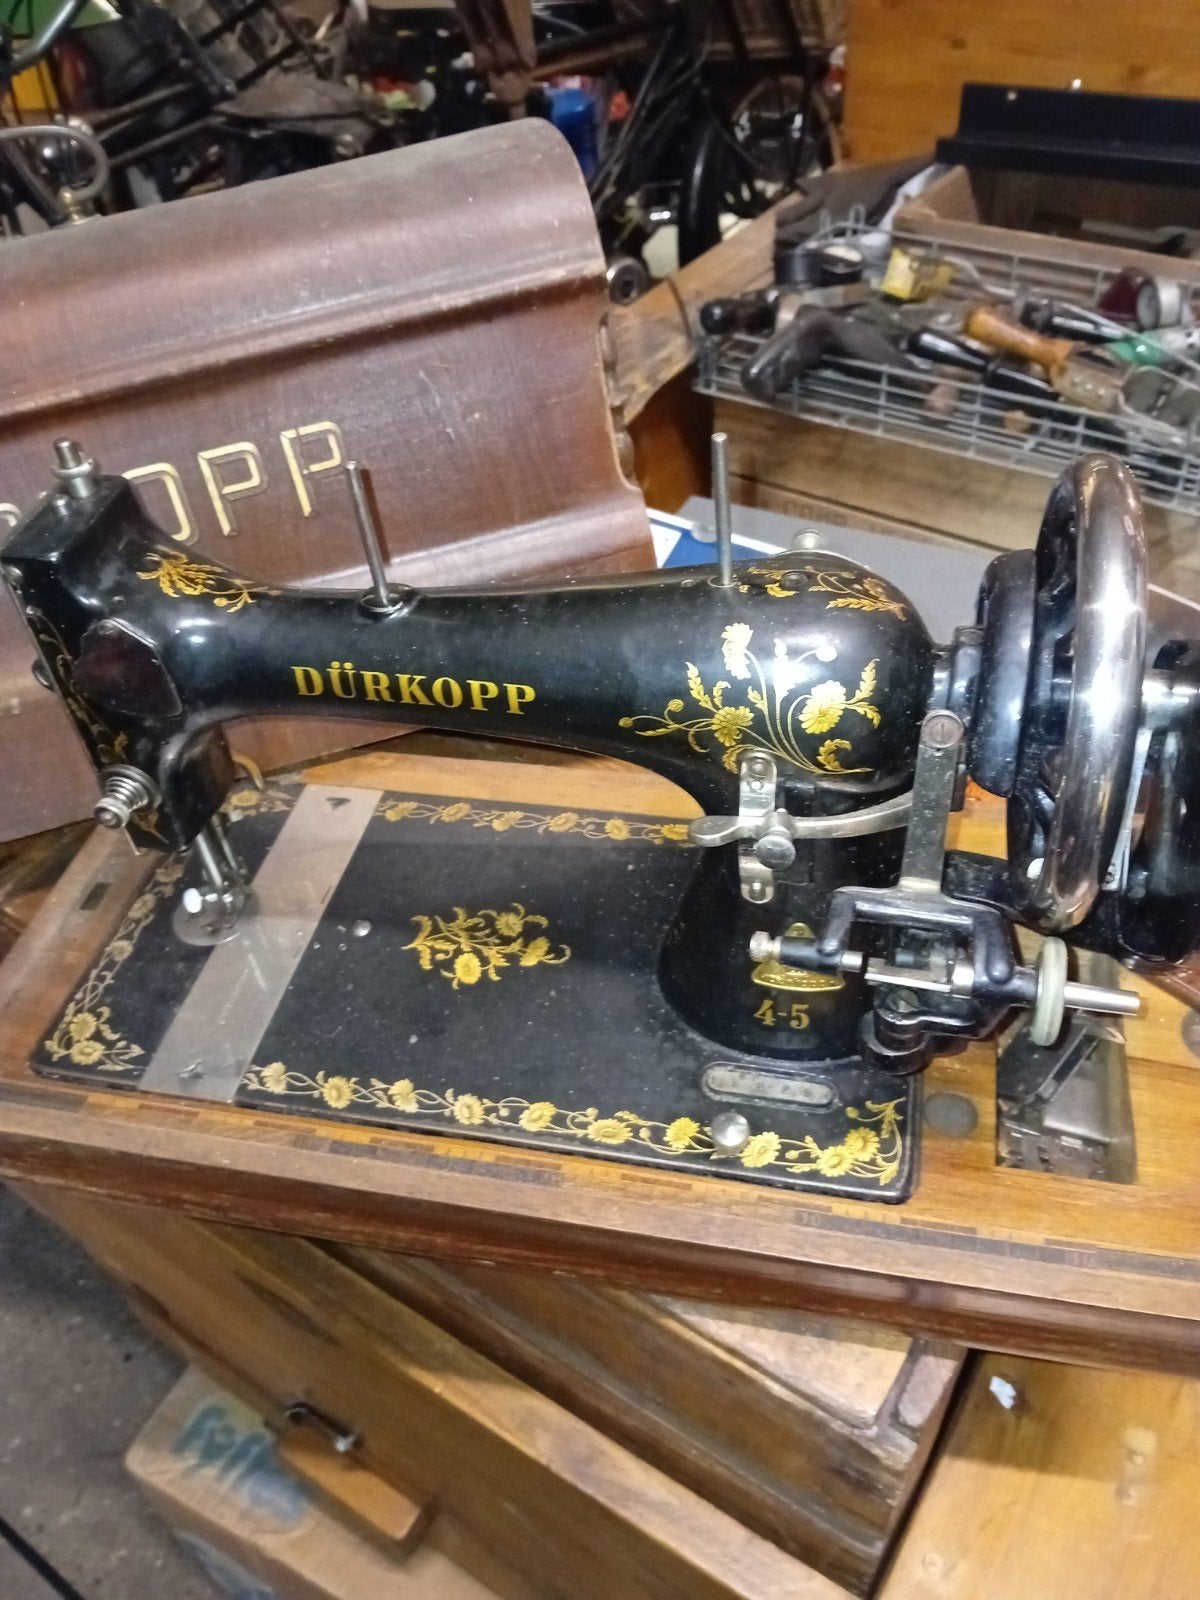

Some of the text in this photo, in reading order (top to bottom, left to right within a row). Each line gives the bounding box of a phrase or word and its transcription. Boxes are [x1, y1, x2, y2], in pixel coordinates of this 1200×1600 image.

[0, 421, 341, 542] OPP
[291, 661, 536, 715] DÜRKOPP
[754, 1000, 810, 1029] 4-5
